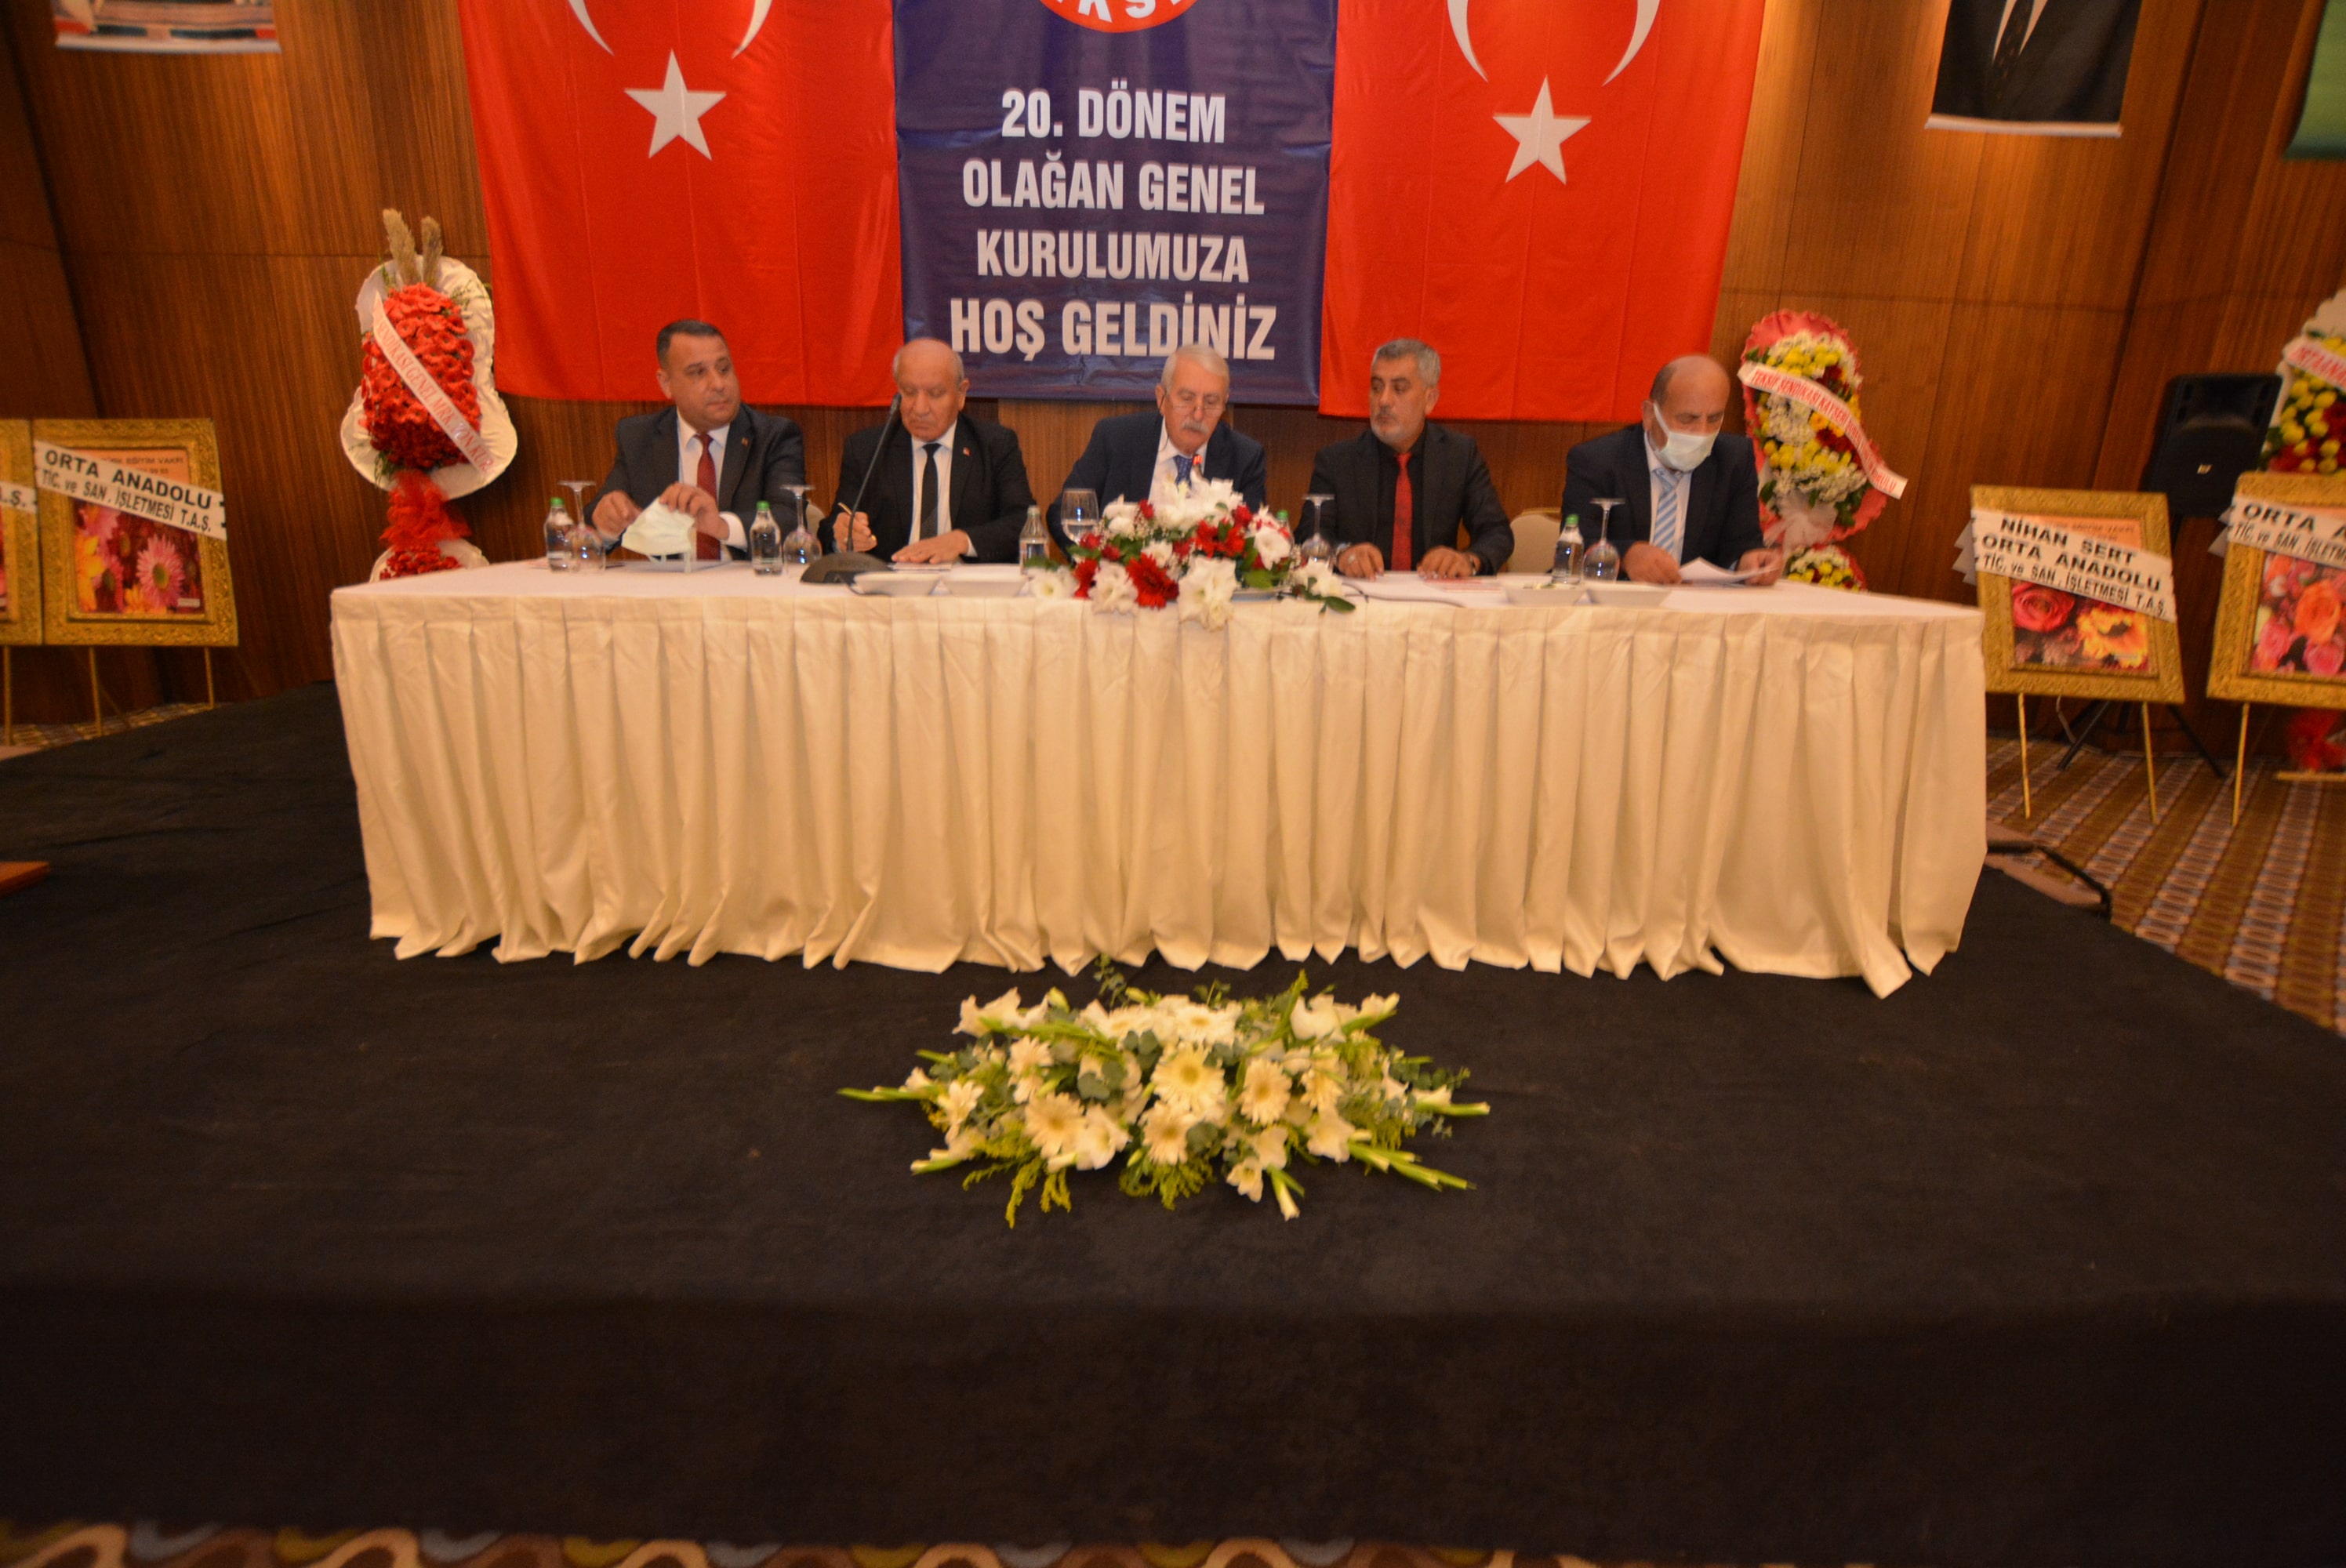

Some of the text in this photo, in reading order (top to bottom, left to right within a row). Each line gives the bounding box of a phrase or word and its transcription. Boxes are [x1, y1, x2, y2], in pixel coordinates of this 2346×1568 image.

[1000, 78, 1226, 143] 20. DÖNEM
[962, 148, 1265, 215] OLAĞAN GENEL
[976, 228, 1250, 283] KURULUMUZA
[950, 291, 1277, 361] HOŞ GELDİNİZ
[45, 449, 212, 509] ORTA ANADOLU
[2000, 516, 2136, 564] NİHAN SERT
[2243, 503, 2315, 532] ORTA
[1981, 534, 2161, 592] ORTA ANADOLU
